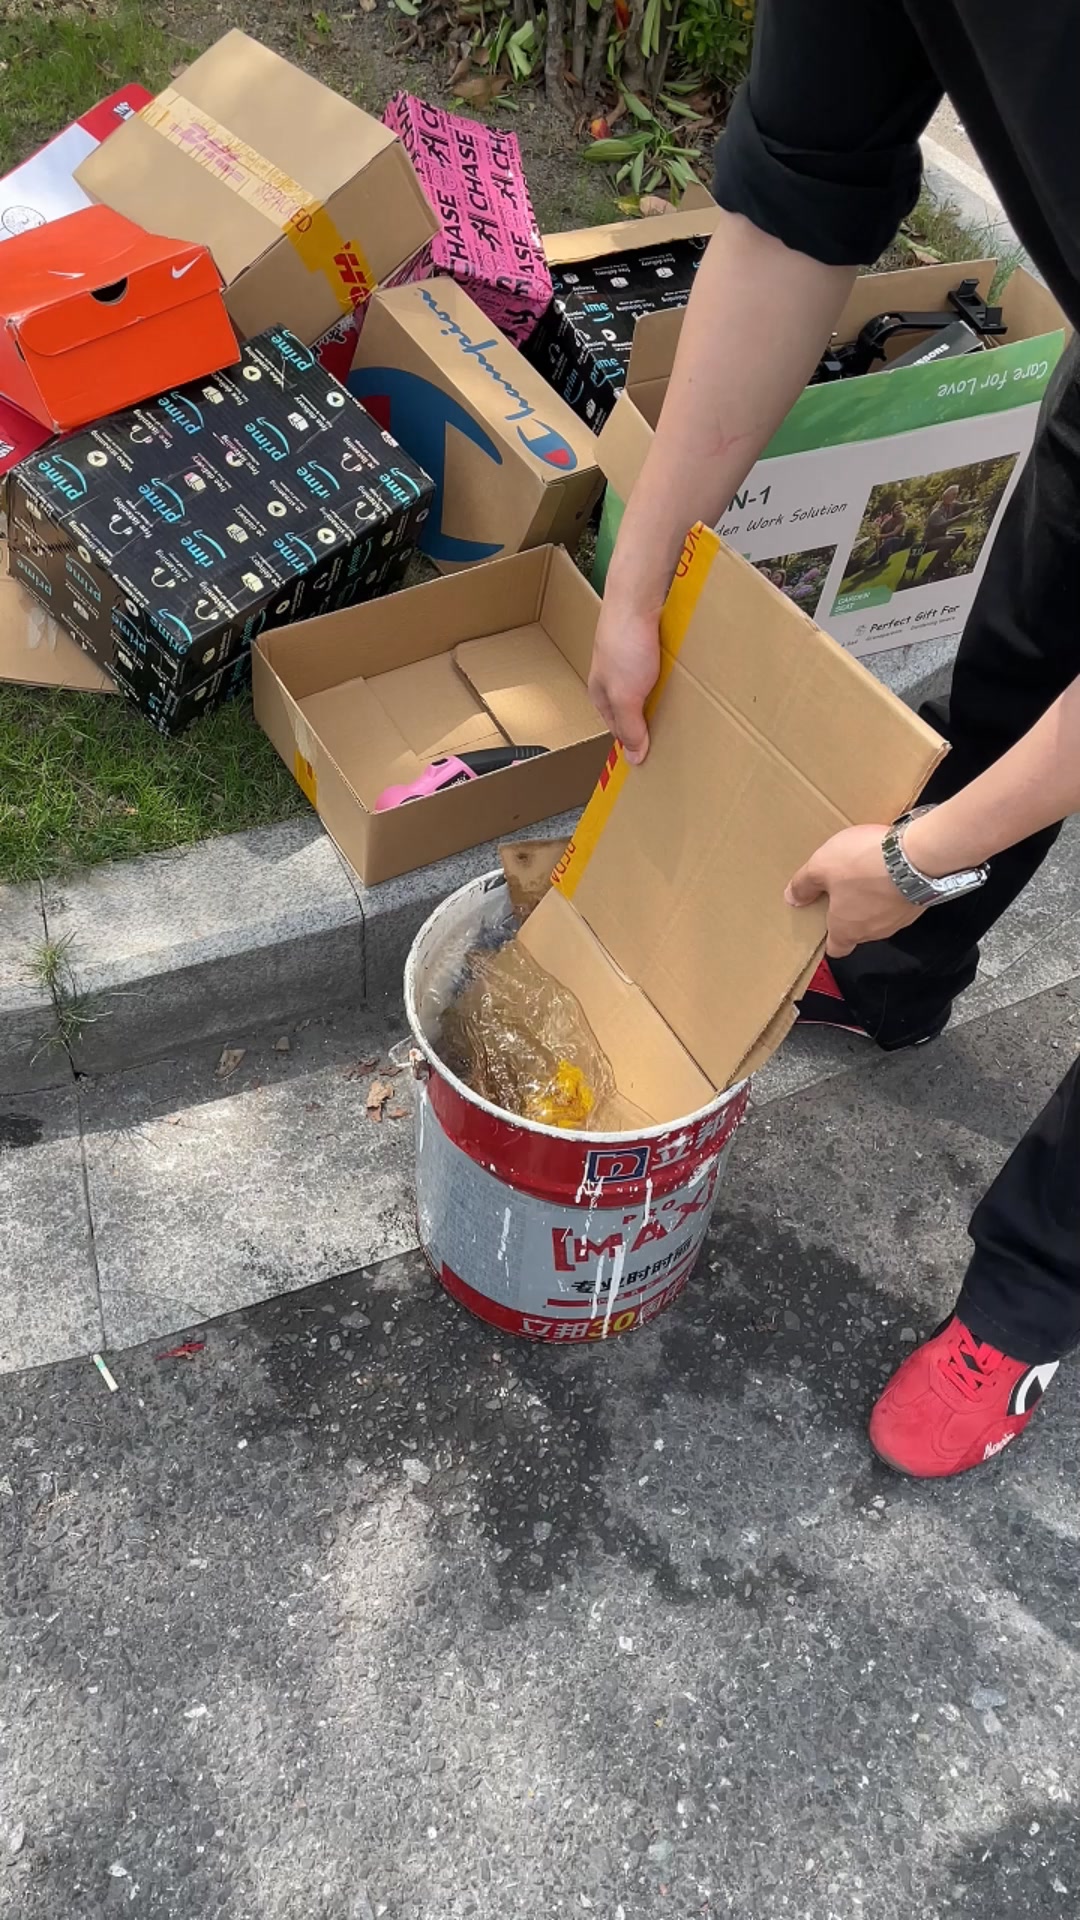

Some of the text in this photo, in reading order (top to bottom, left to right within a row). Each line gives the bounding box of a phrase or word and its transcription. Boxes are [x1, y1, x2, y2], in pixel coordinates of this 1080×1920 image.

[455, 130, 489, 211] CHASE
[270, 333, 311, 372] prime
[210, 372, 233, 393] deliver
[937, 361, 1048, 397] Care for Love
[157, 396, 200, 435] prime
[242, 422, 286, 462] prime
[37, 460, 83, 501] prime
[728, 485, 772, 512] N-1
[136, 483, 180, 524] prime
[716, 502, 848, 537] den Work Solution
[66, 520, 99, 549] streaming
[177, 536, 213, 569] rime
[17, 551, 50, 599] prime
[66, 558, 100, 604] prime
[112, 612, 145, 655] prime
[869, 605, 961, 632] Perfect Gift For
